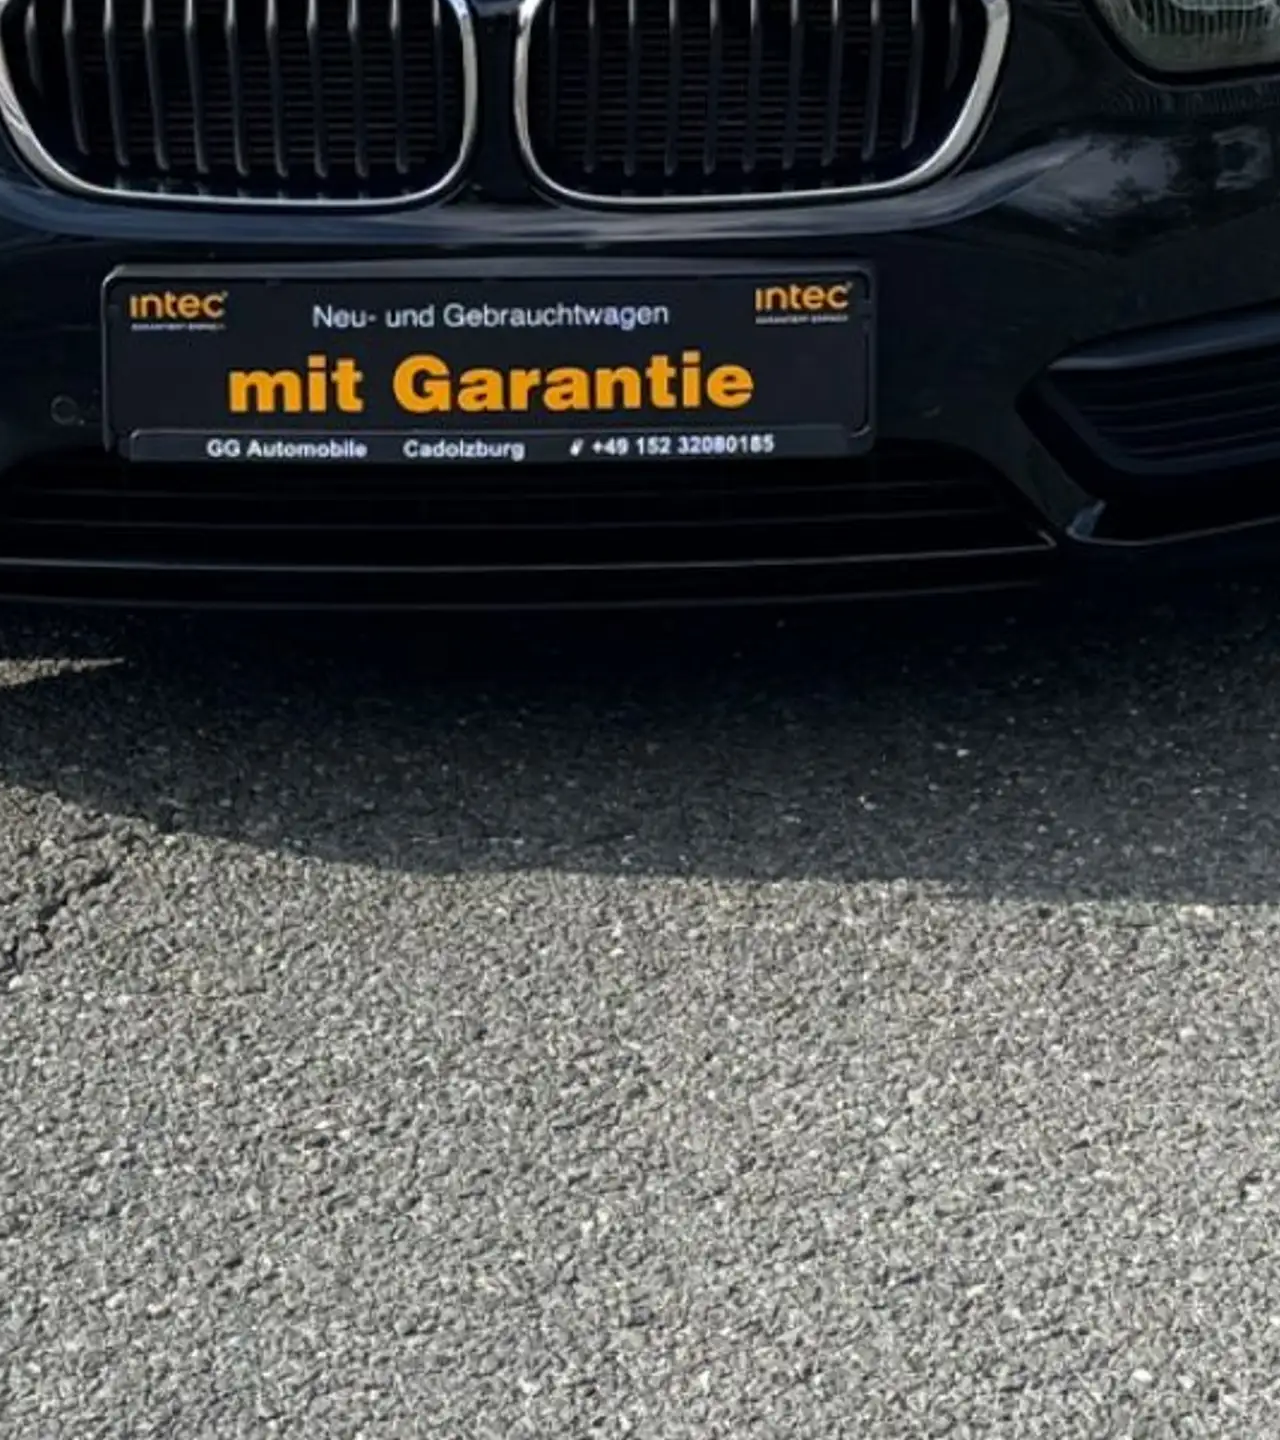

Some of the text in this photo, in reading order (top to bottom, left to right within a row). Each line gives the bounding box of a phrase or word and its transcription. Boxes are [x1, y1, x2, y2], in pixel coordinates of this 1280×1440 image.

[312, 302, 669, 331] Neu- und Gebrauchtwagen
[229, 350, 755, 413] mit Garantie
[206, 438, 240, 458] GG
[246, 438, 369, 458] Automobile
[402, 438, 526, 462] Cadolzburg
[591, 436, 630, 456] +49
[635, 436, 671, 456] 152
